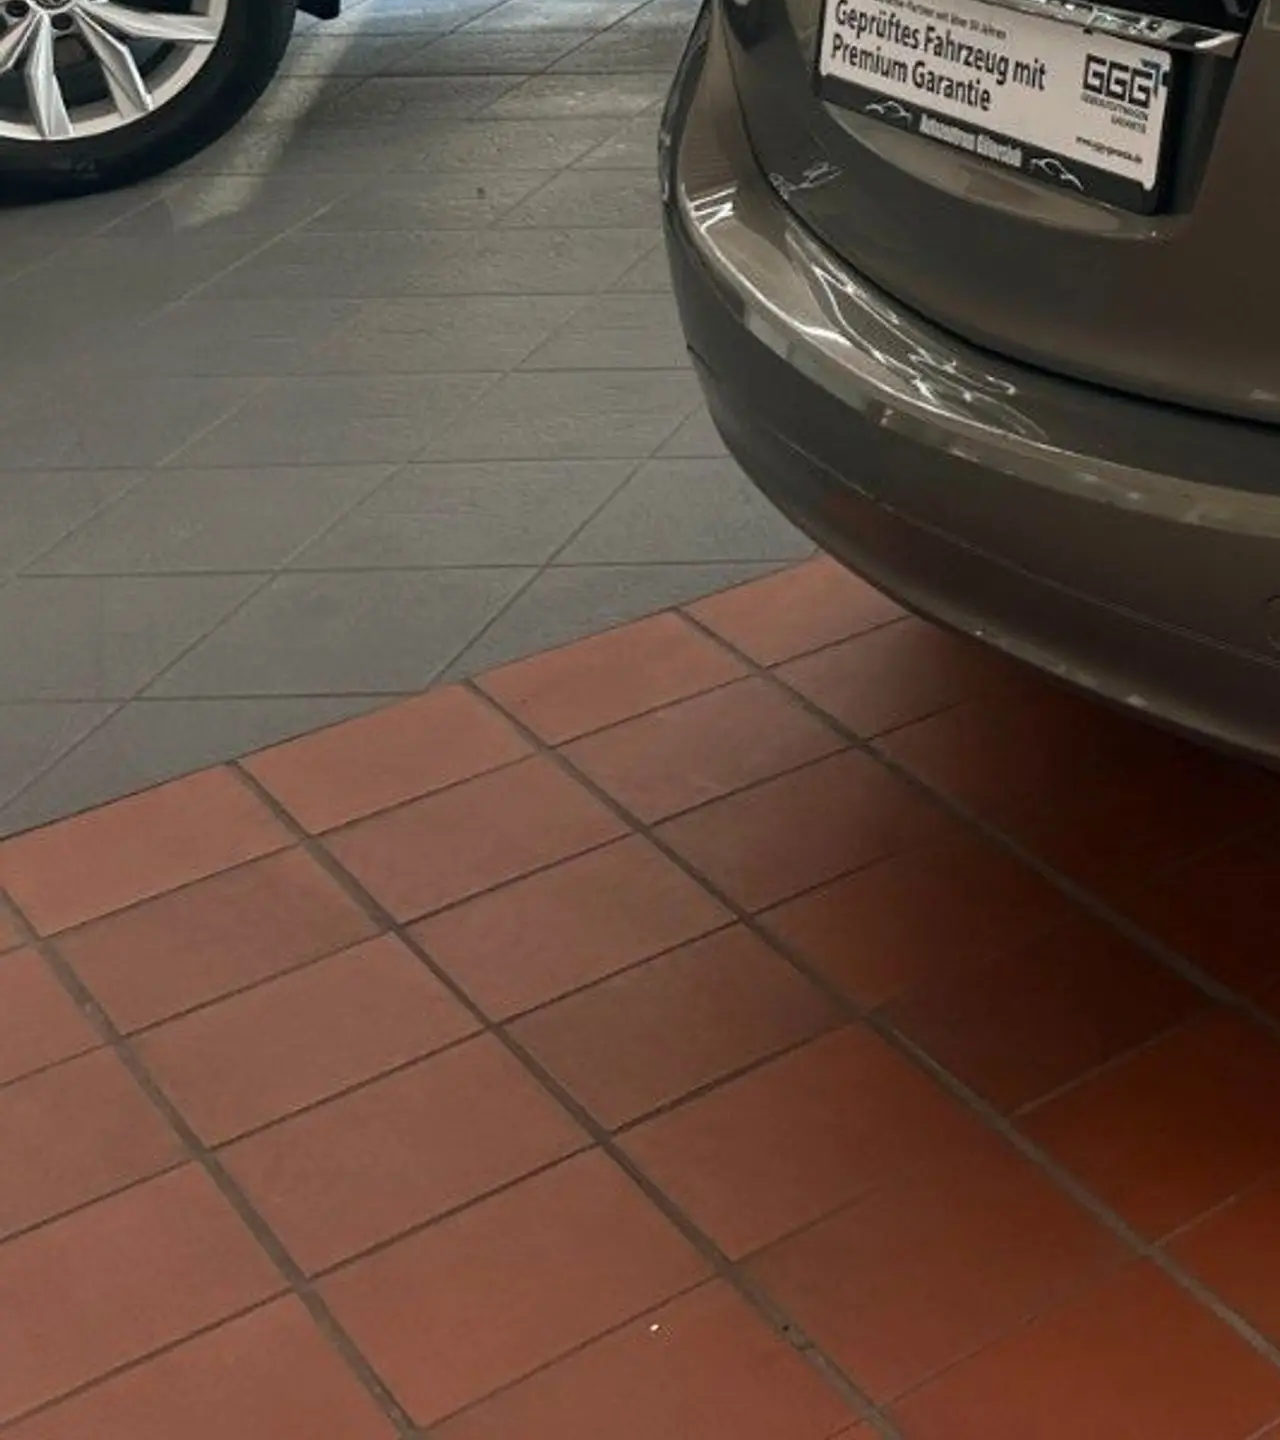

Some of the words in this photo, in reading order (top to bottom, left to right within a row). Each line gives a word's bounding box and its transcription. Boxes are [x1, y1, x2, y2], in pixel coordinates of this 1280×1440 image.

[831, 34, 908, 83] Premium
[912, 61, 991, 111] Garantie
[924, 24, 1009, 85] Fahrzeug
[1012, 58, 1046, 91] mit
[1083, 53, 1151, 109] GGG
